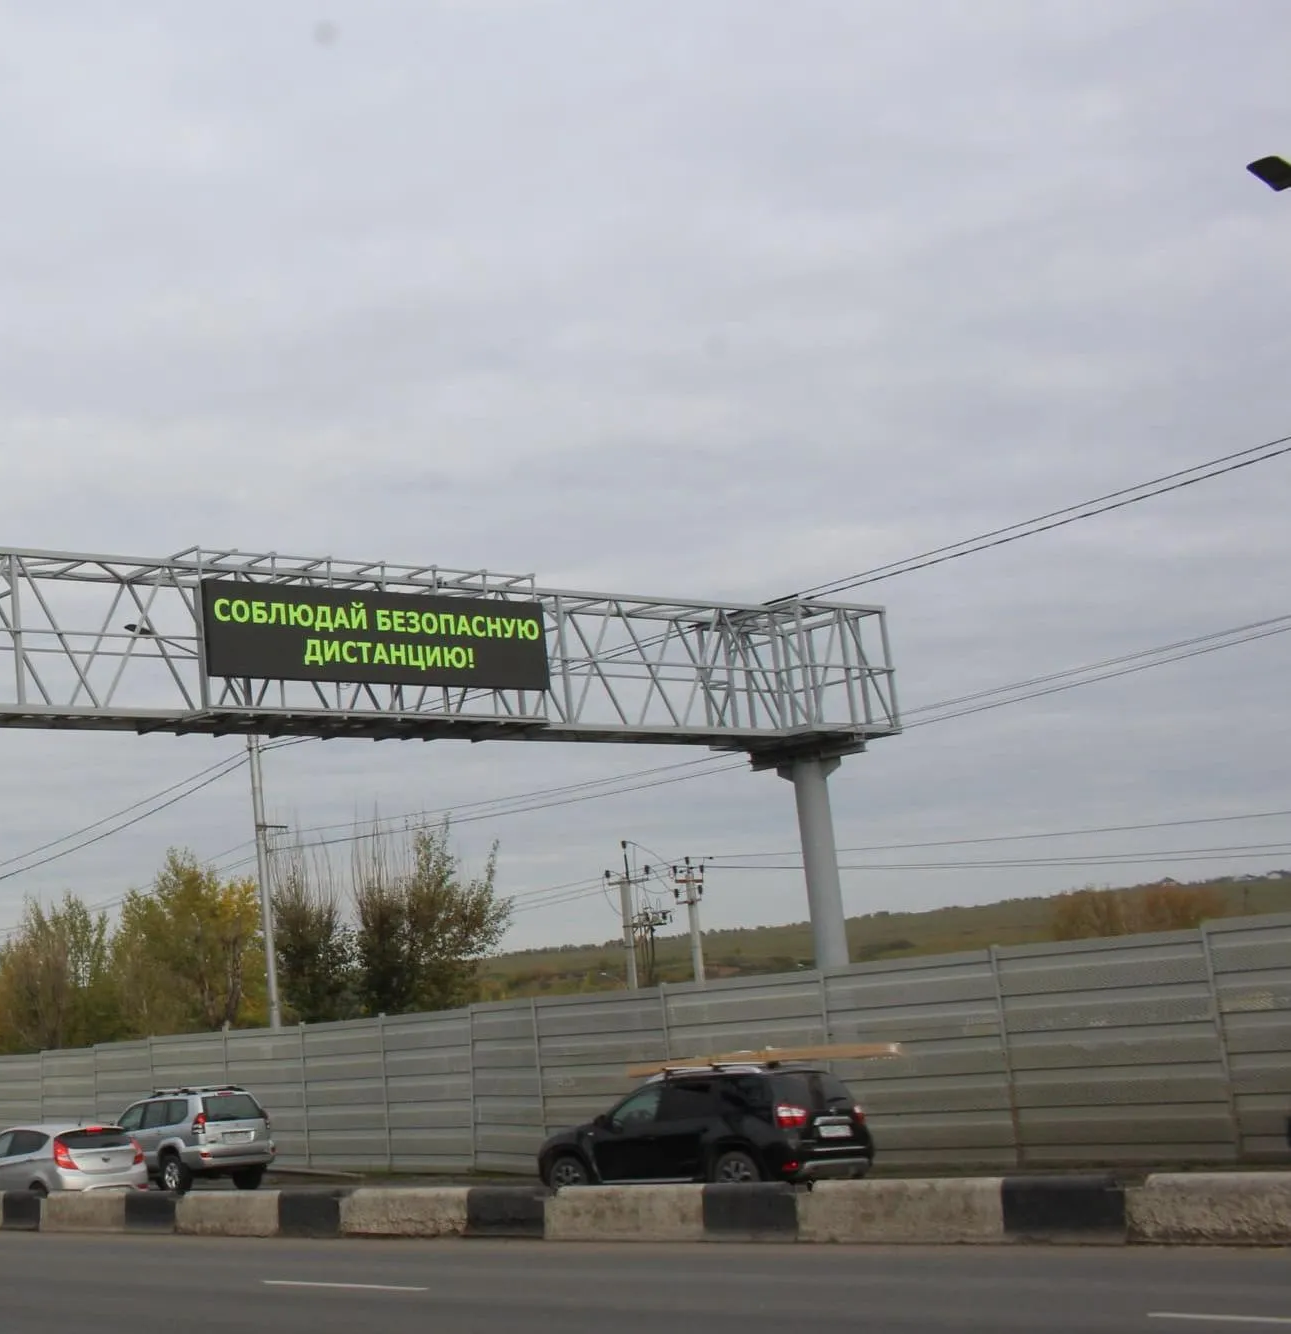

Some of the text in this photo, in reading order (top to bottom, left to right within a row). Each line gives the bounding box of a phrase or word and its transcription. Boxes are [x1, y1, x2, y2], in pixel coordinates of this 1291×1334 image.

[213, 598, 540, 641] СОБЛЮДАЙ БЕЗОПАСНУЮ
[303, 638, 475, 671] ДИСТАНЦИЮ!
